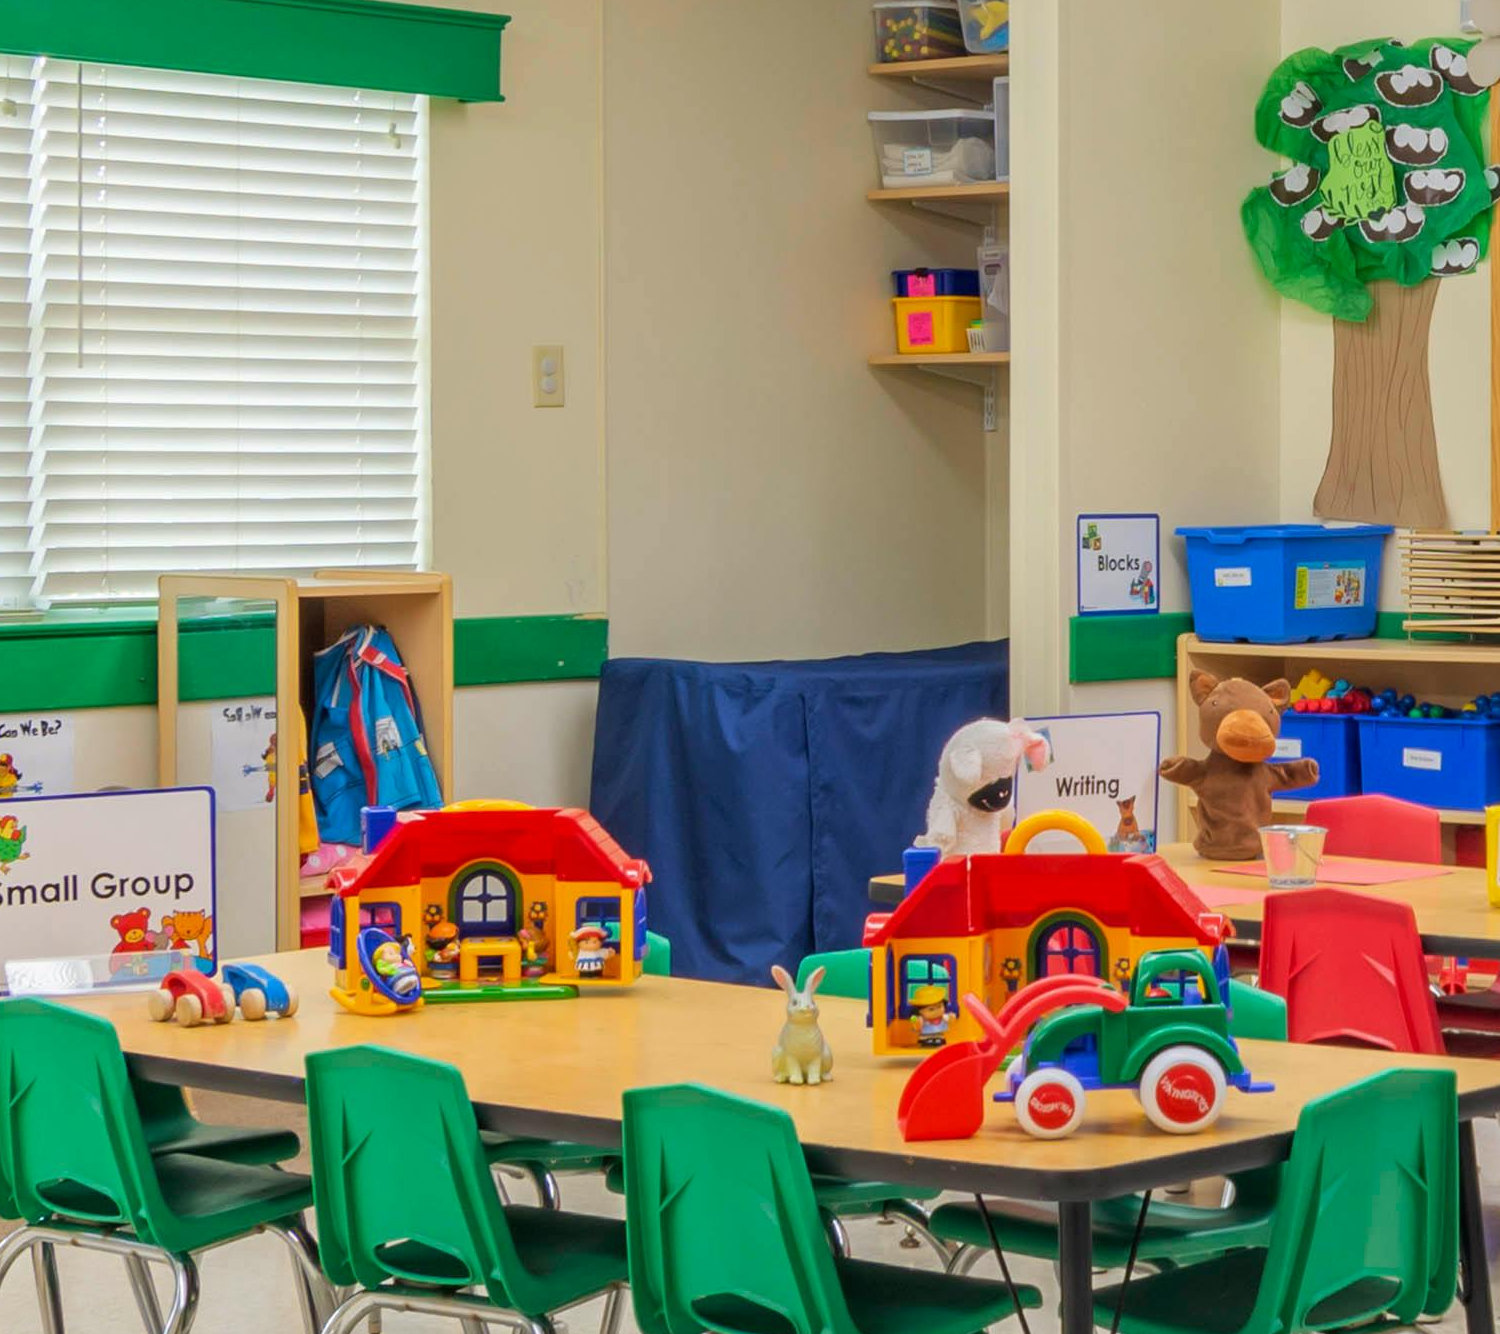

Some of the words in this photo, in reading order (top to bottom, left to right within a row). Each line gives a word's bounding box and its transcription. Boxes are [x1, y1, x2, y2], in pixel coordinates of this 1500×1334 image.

[1097, 553, 1141, 573] Blocks
[20, 719, 39, 738] We
[40, 718, 63, 737] Be?
[1055, 774, 1121, 801] Writing
[90, 871, 195, 901] Group
